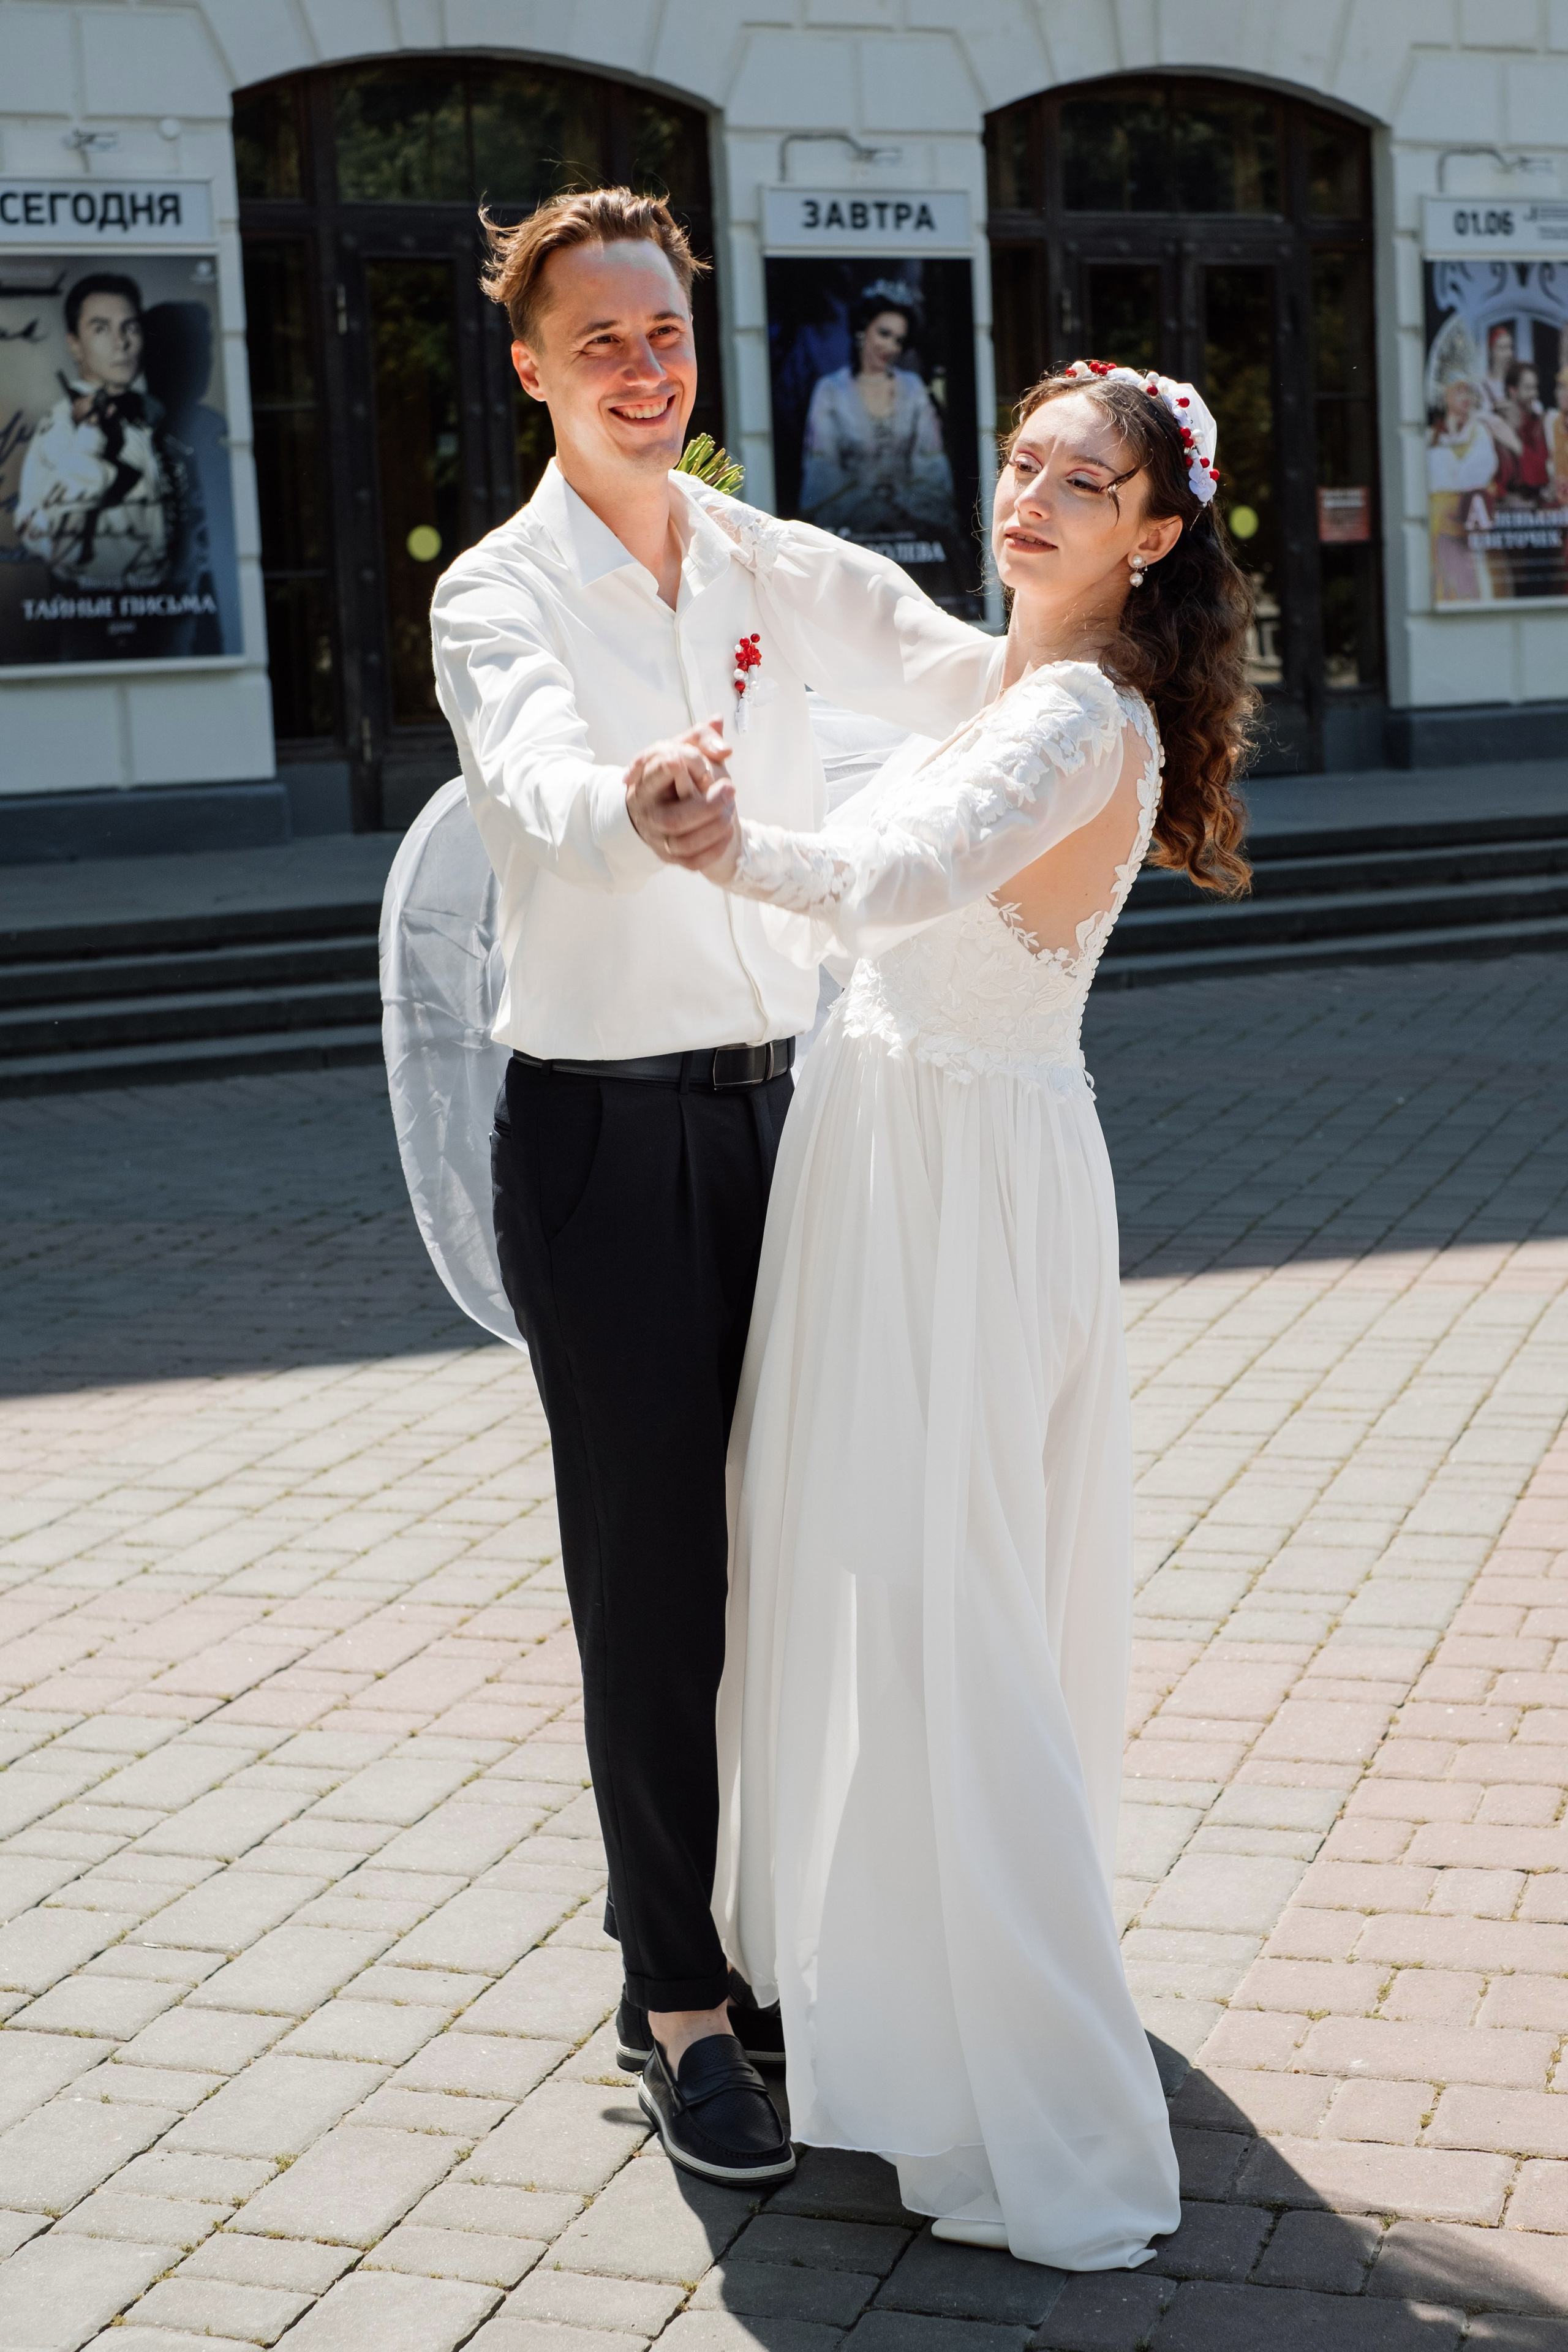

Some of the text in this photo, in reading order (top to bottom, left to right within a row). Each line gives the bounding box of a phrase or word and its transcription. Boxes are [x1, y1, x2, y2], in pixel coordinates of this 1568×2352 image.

[0, 191, 181, 232] СЕГОДНЯ
[802, 200, 936, 231] ЗАВТРА
[119, 593, 217, 617] ПИСЬМА
